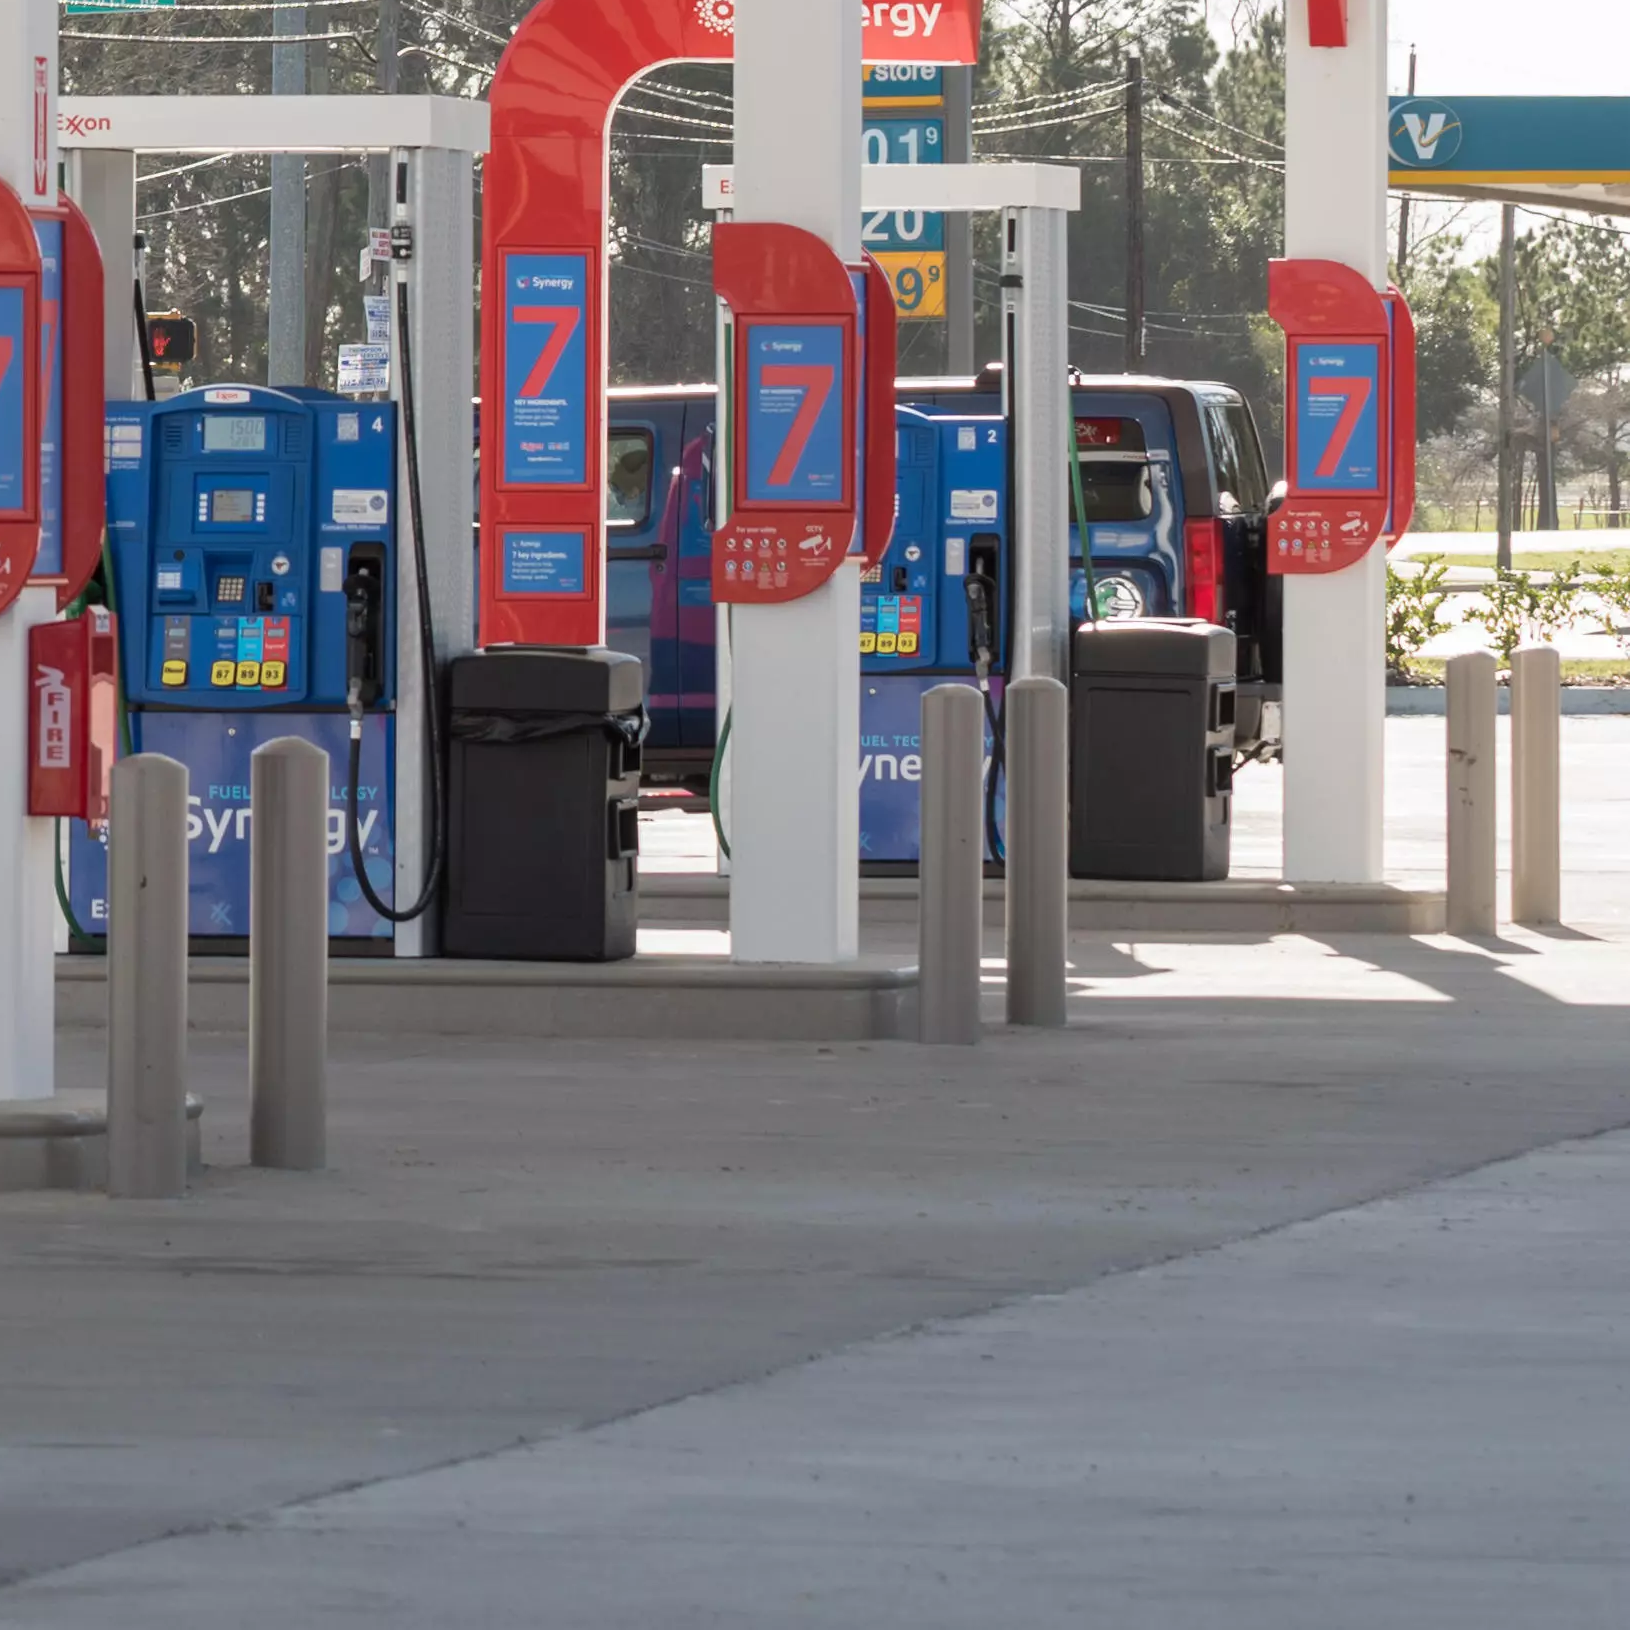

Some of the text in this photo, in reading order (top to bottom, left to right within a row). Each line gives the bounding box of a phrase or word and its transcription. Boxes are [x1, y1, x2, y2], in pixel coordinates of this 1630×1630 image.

[861, 3, 942, 37] ergy
[531, 276, 574, 290] Synergy
[513, 306, 580, 397] 7
[372, 416, 383, 433] 4
[760, 365, 834, 486] 7
[1308, 377, 1372, 477] 7
[987, 430, 998, 443] 2
[216, 670, 230, 679] 87
[240, 670, 255, 679] 89
[265, 670, 279, 679] 93
[46, 692, 65, 761] FIRE
[209, 785, 251, 800] FUEL
